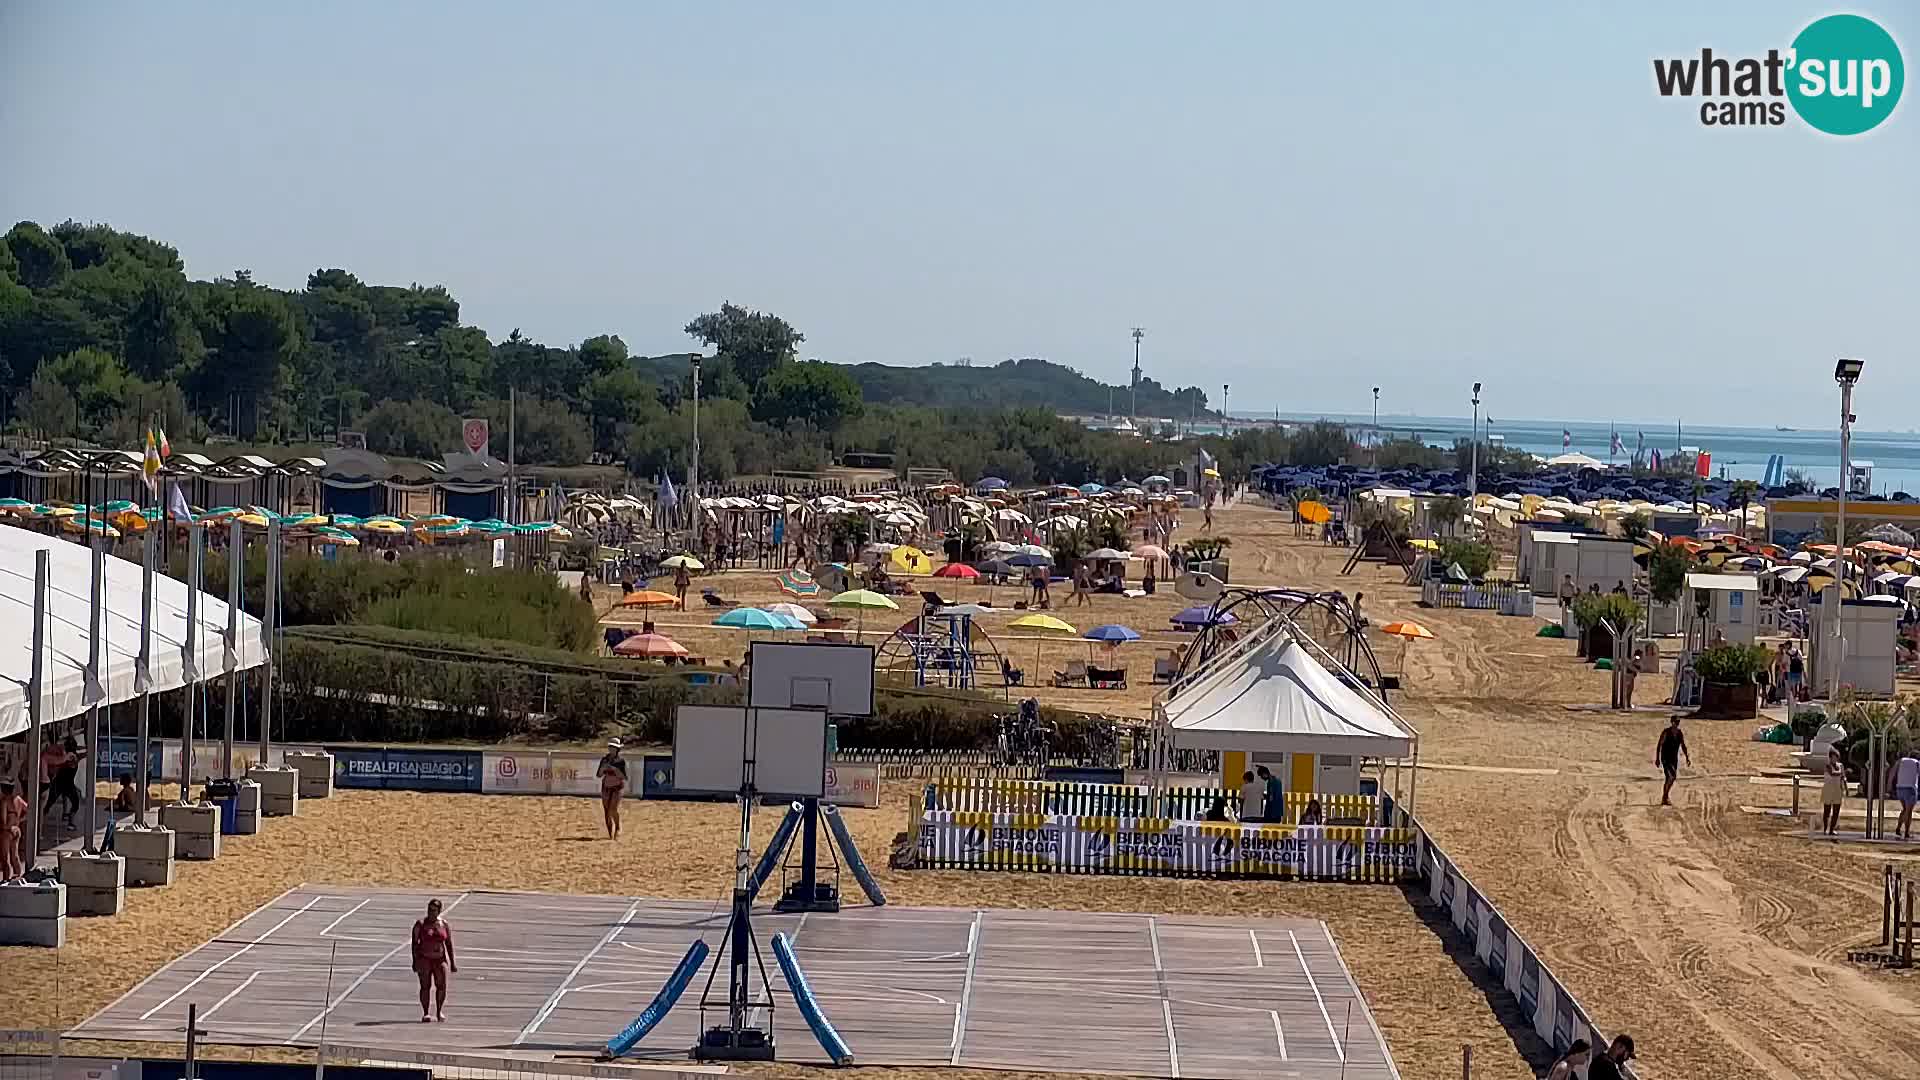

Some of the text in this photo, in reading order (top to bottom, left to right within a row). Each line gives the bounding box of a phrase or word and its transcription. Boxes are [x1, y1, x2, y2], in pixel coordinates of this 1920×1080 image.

[993, 827, 1060, 842] BIBIONE
[1117, 832, 1183, 847] BIBIONE
[992, 840, 1059, 854] SPIAGGIA
[1117, 845, 1183, 858] SPIAGGIA
[1240, 837, 1307, 852] BIBIONE
[1240, 850, 1307, 864] SPIAGGIA
